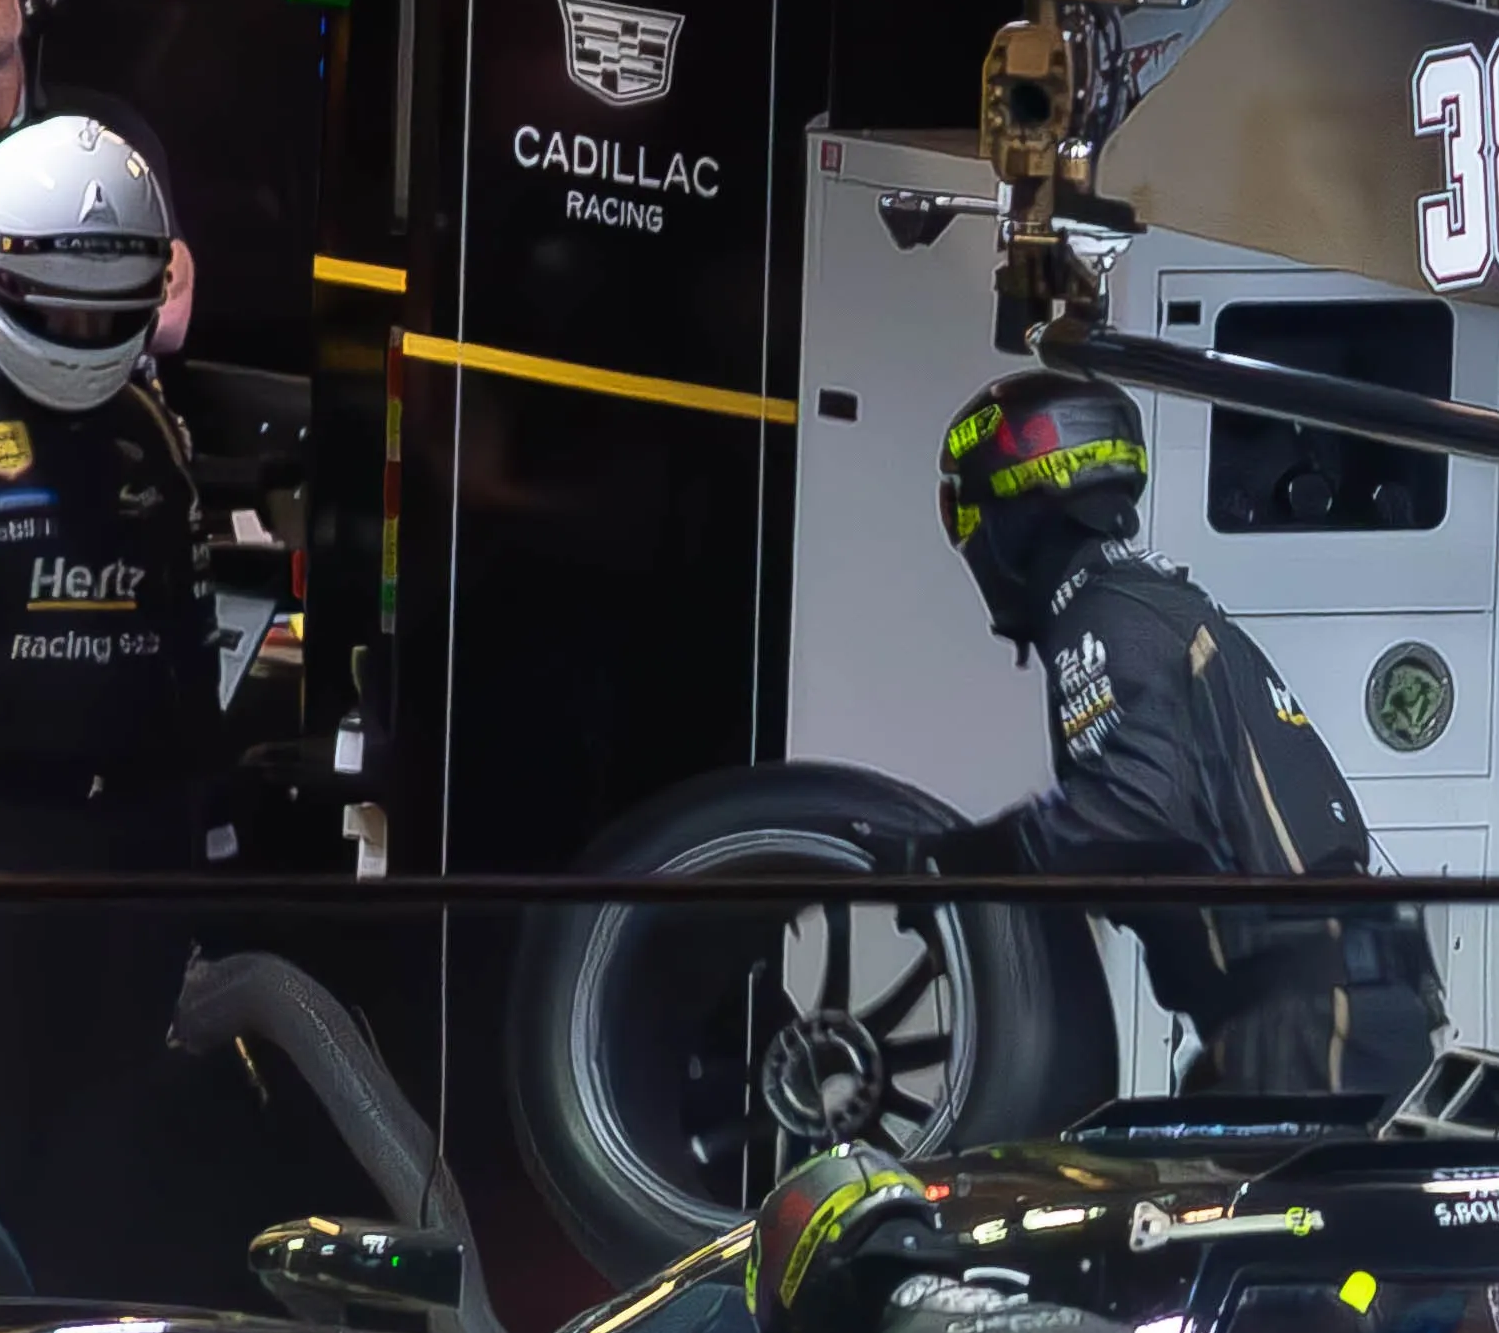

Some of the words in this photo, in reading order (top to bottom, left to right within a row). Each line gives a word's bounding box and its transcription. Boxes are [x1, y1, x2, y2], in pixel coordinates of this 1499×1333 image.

[513, 123, 720, 200] CADILLAC
[566, 189, 664, 234] RACING
[29, 555, 148, 600] Hertz
[10, 629, 112, 664] Racing
